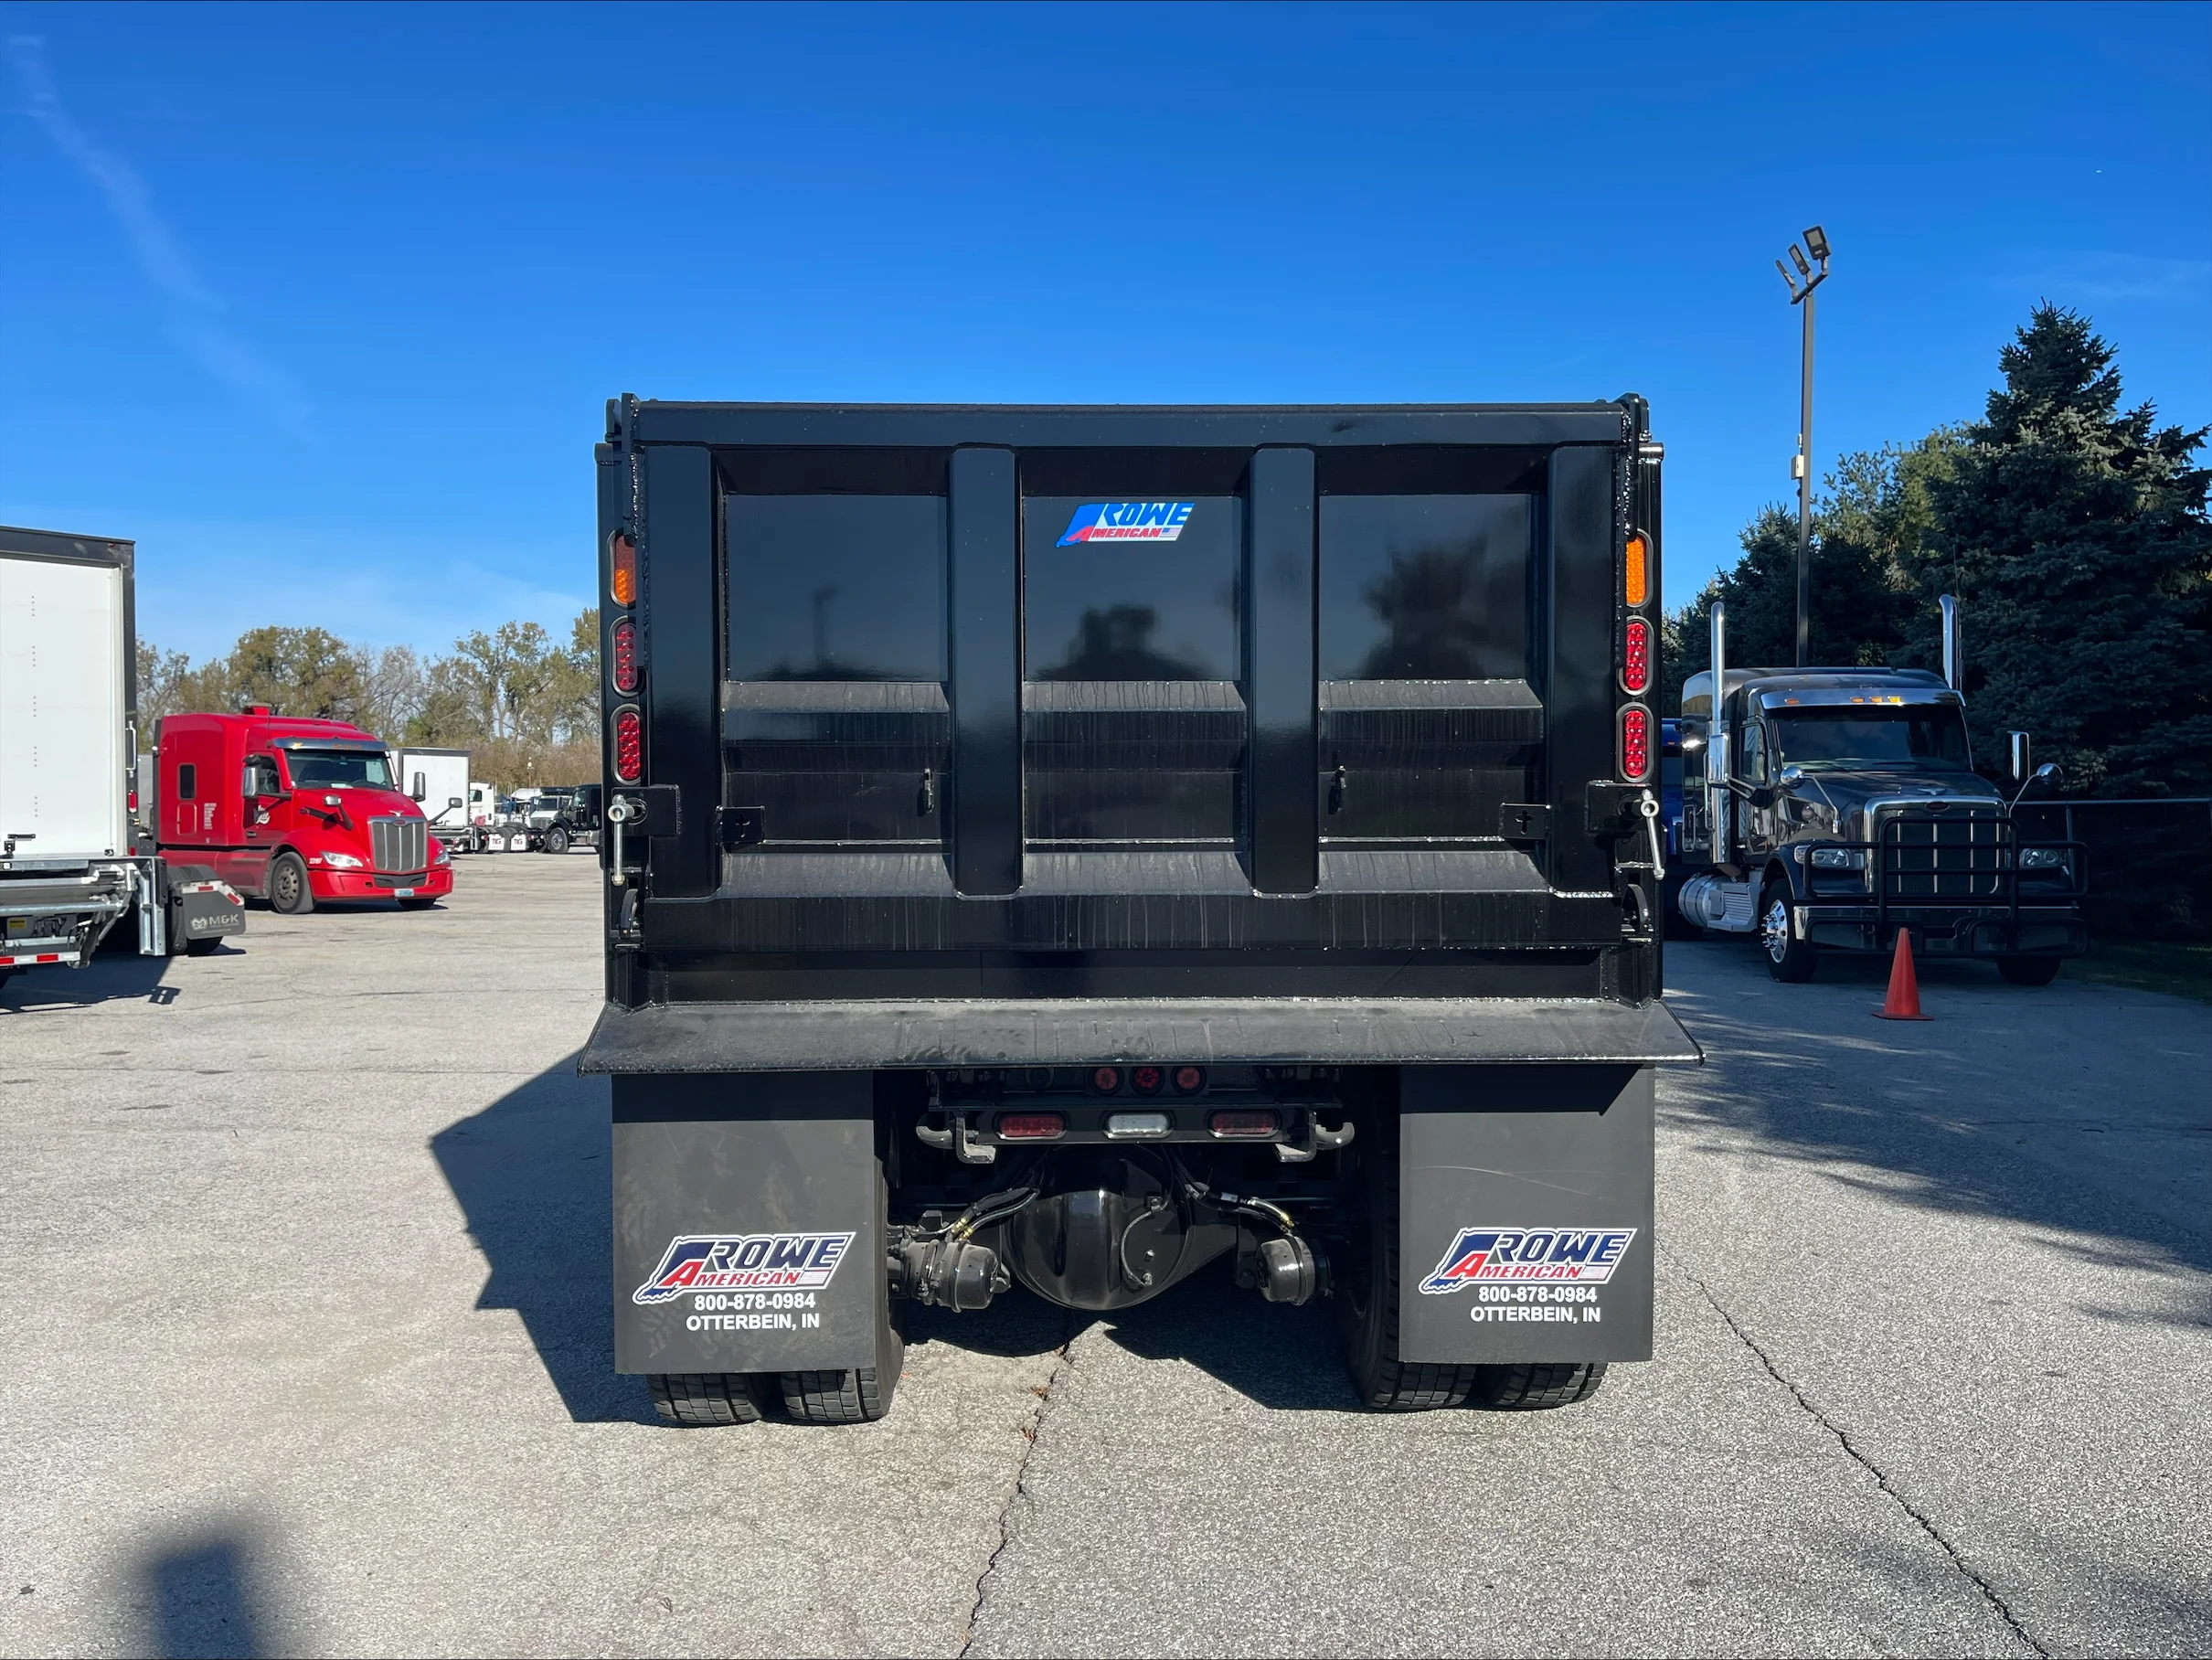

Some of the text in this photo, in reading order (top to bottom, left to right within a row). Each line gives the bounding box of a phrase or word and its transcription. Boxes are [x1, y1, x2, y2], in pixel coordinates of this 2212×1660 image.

[1097, 503, 1194, 526] ROWE
[1066, 526, 1162, 541] AMERICAN
[208, 914, 239, 926] M&K
[707, 1236, 847, 1270] ROWE
[1494, 1231, 1628, 1264] ROWE
[657, 1261, 802, 1287] AMERICAN
[1443, 1253, 1583, 1278] AMERICAN
[694, 1292, 816, 1312] 800-878-0984
[1478, 1285, 1598, 1304] 800-878-0984
[686, 1313, 820, 1331] OTTERBEIN, IN
[1470, 1306, 1601, 1324] OTTERBEIN, IN
